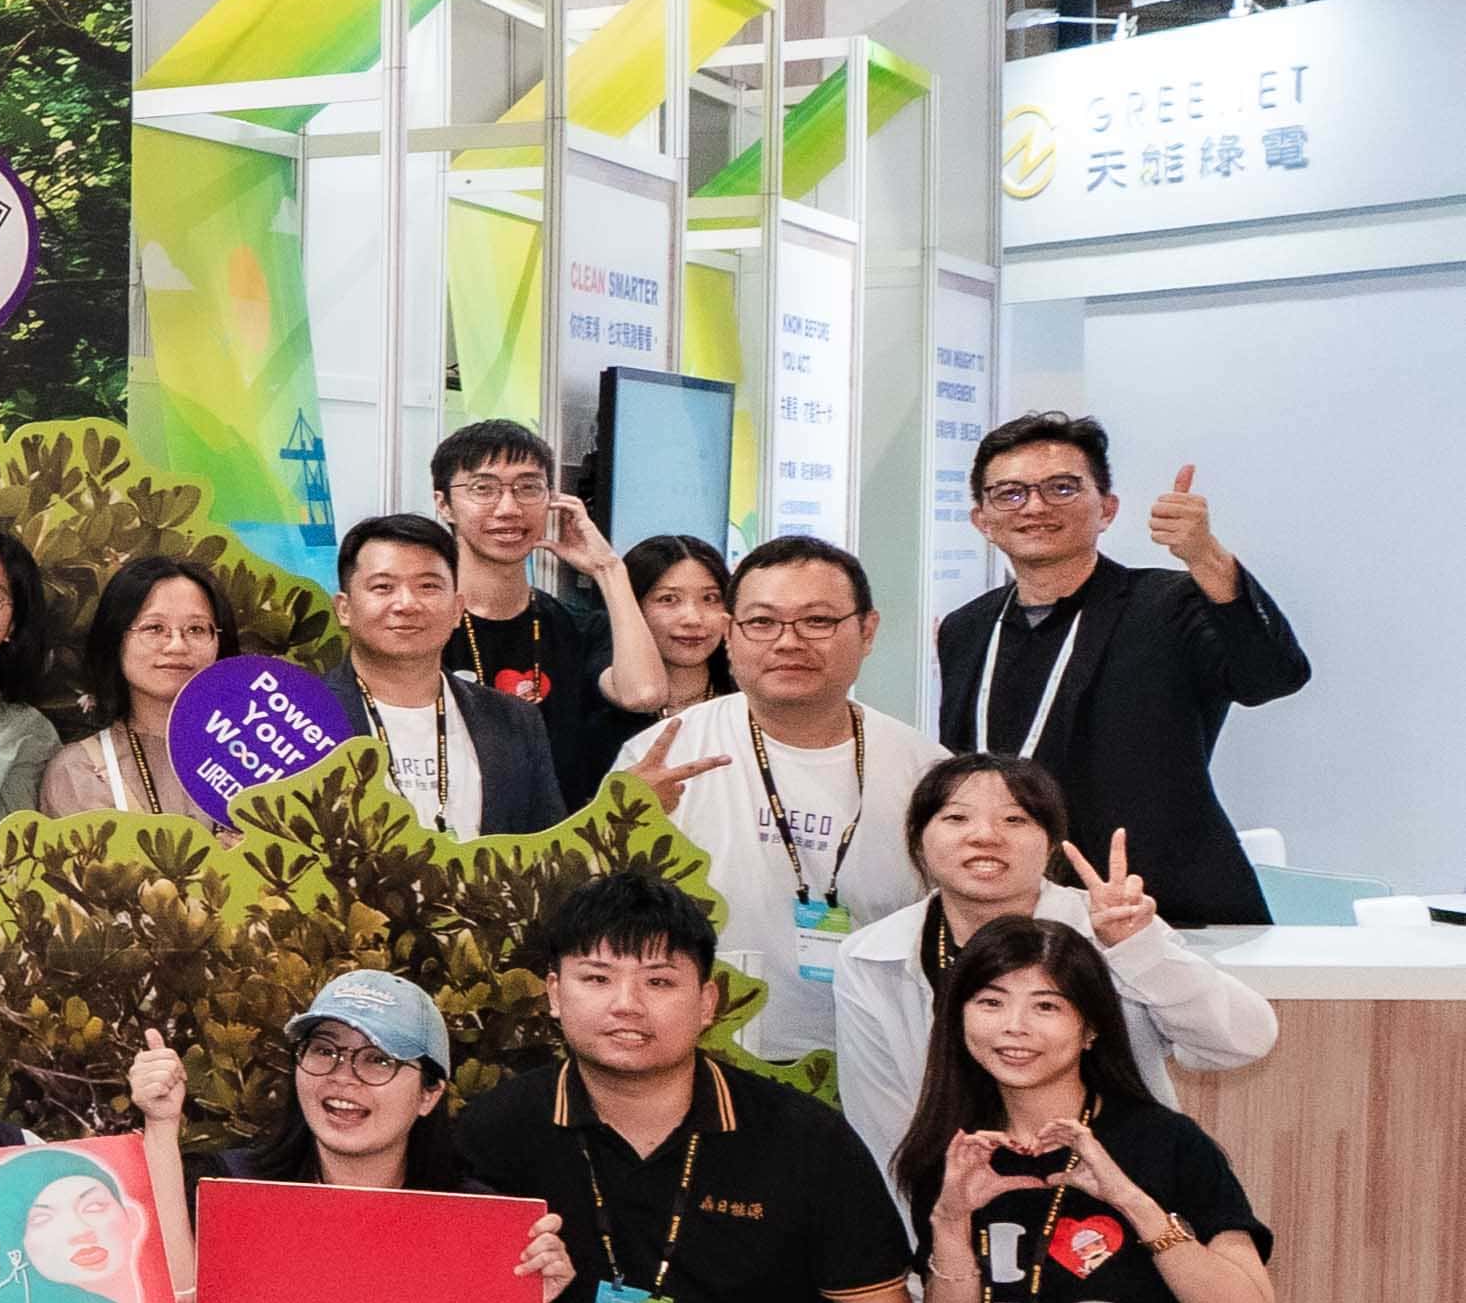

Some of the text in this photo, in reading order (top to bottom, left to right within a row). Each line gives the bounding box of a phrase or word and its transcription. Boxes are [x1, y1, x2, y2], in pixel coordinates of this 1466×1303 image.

[1086, 124, 1309, 192] 天能綠電
[608, 272, 659, 306] SMARTER
[243, 700, 305, 765] Your
[250, 671, 337, 751] Power
[759, 807, 832, 836] UECO
